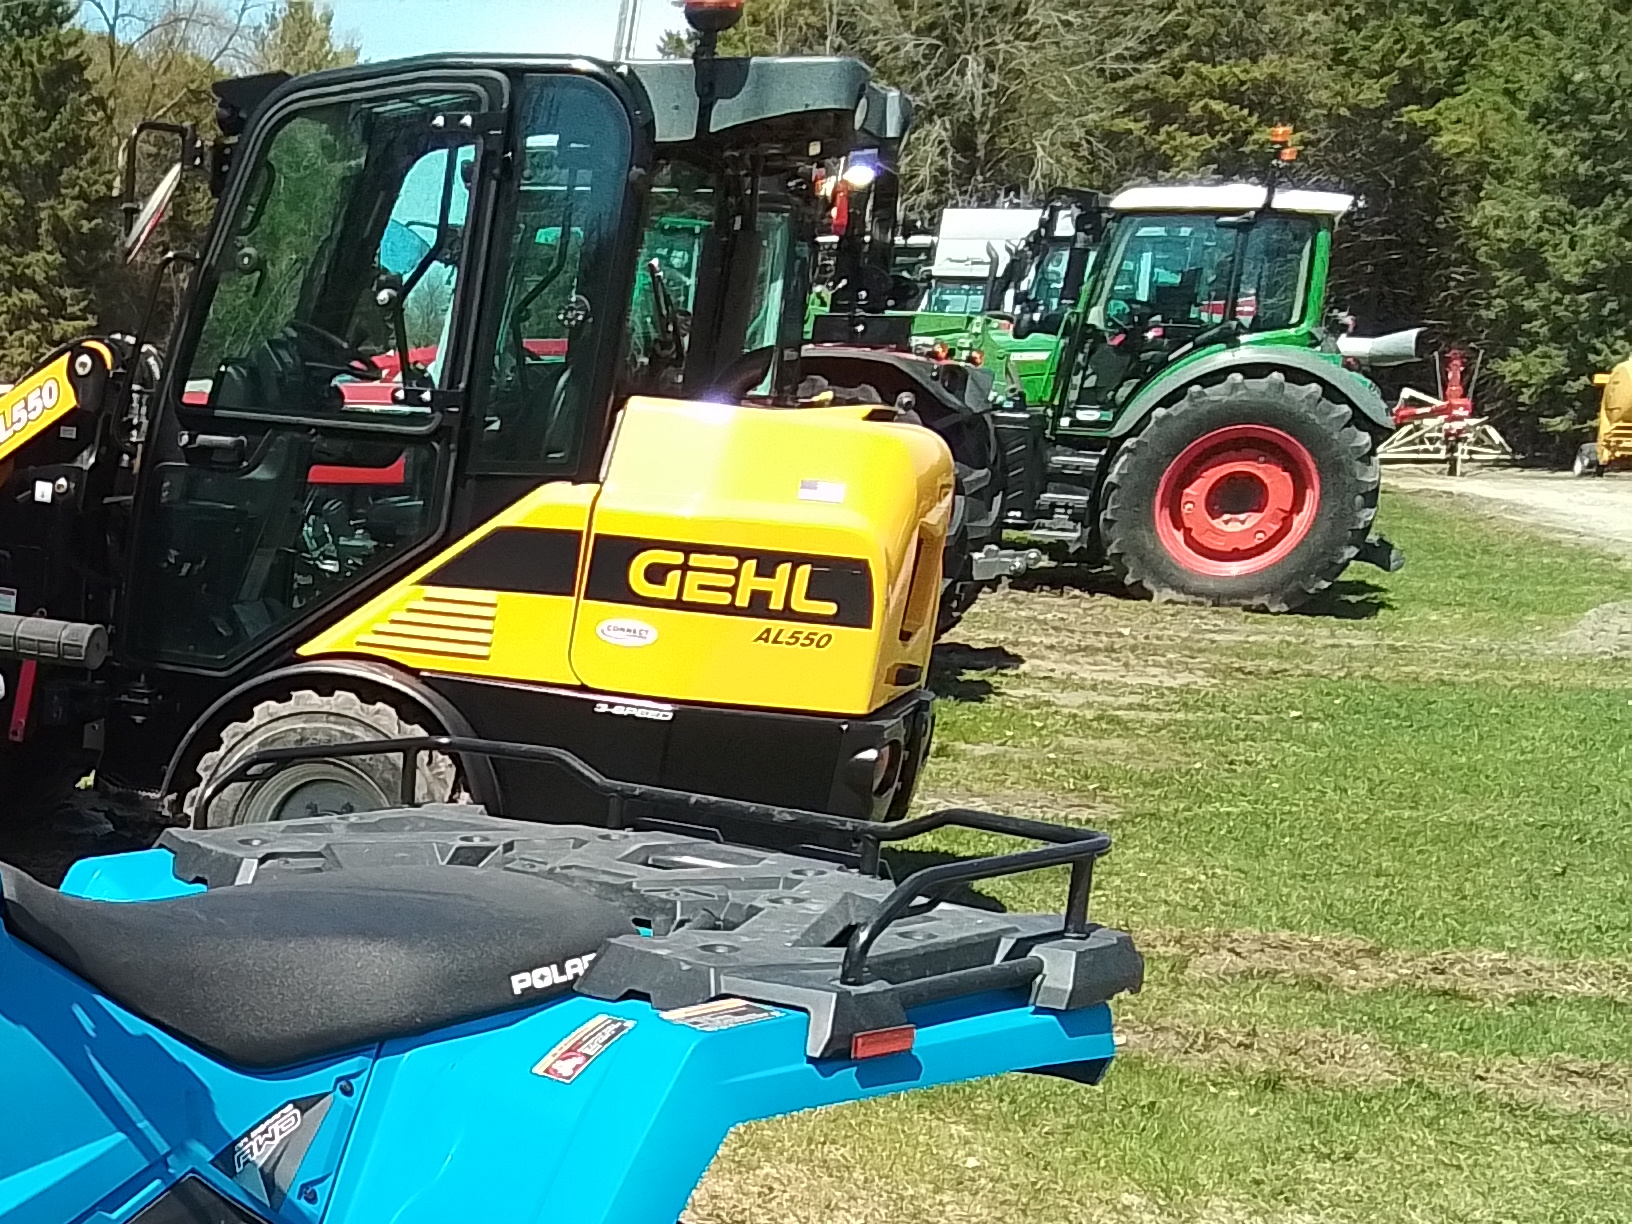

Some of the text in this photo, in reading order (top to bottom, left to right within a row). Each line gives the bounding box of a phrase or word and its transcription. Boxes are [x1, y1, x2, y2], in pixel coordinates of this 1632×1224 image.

[629, 549, 838, 616] GEHL
[753, 627, 834, 650] AL550
[234, 1108, 302, 1174] AWD
